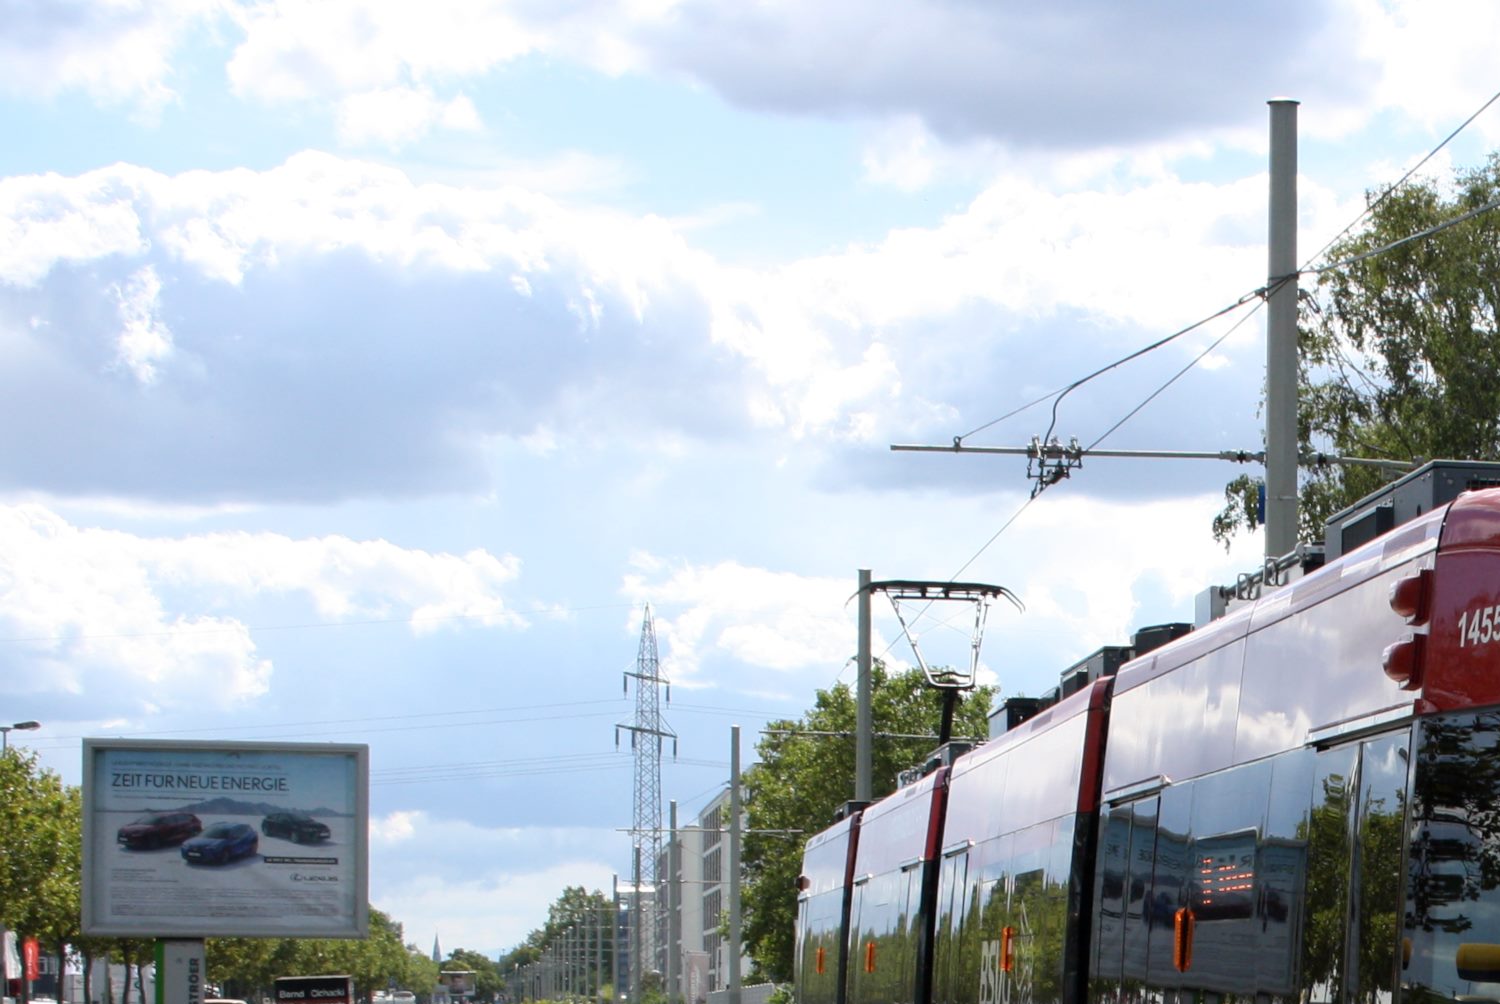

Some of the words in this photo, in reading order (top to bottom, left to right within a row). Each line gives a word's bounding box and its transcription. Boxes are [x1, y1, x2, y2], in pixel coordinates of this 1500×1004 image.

[112, 773, 141, 787] ZEIT
[145, 773, 175, 788] FÜR
[177, 775, 219, 789] NEUE
[222, 776, 290, 791] ENERGIE.
